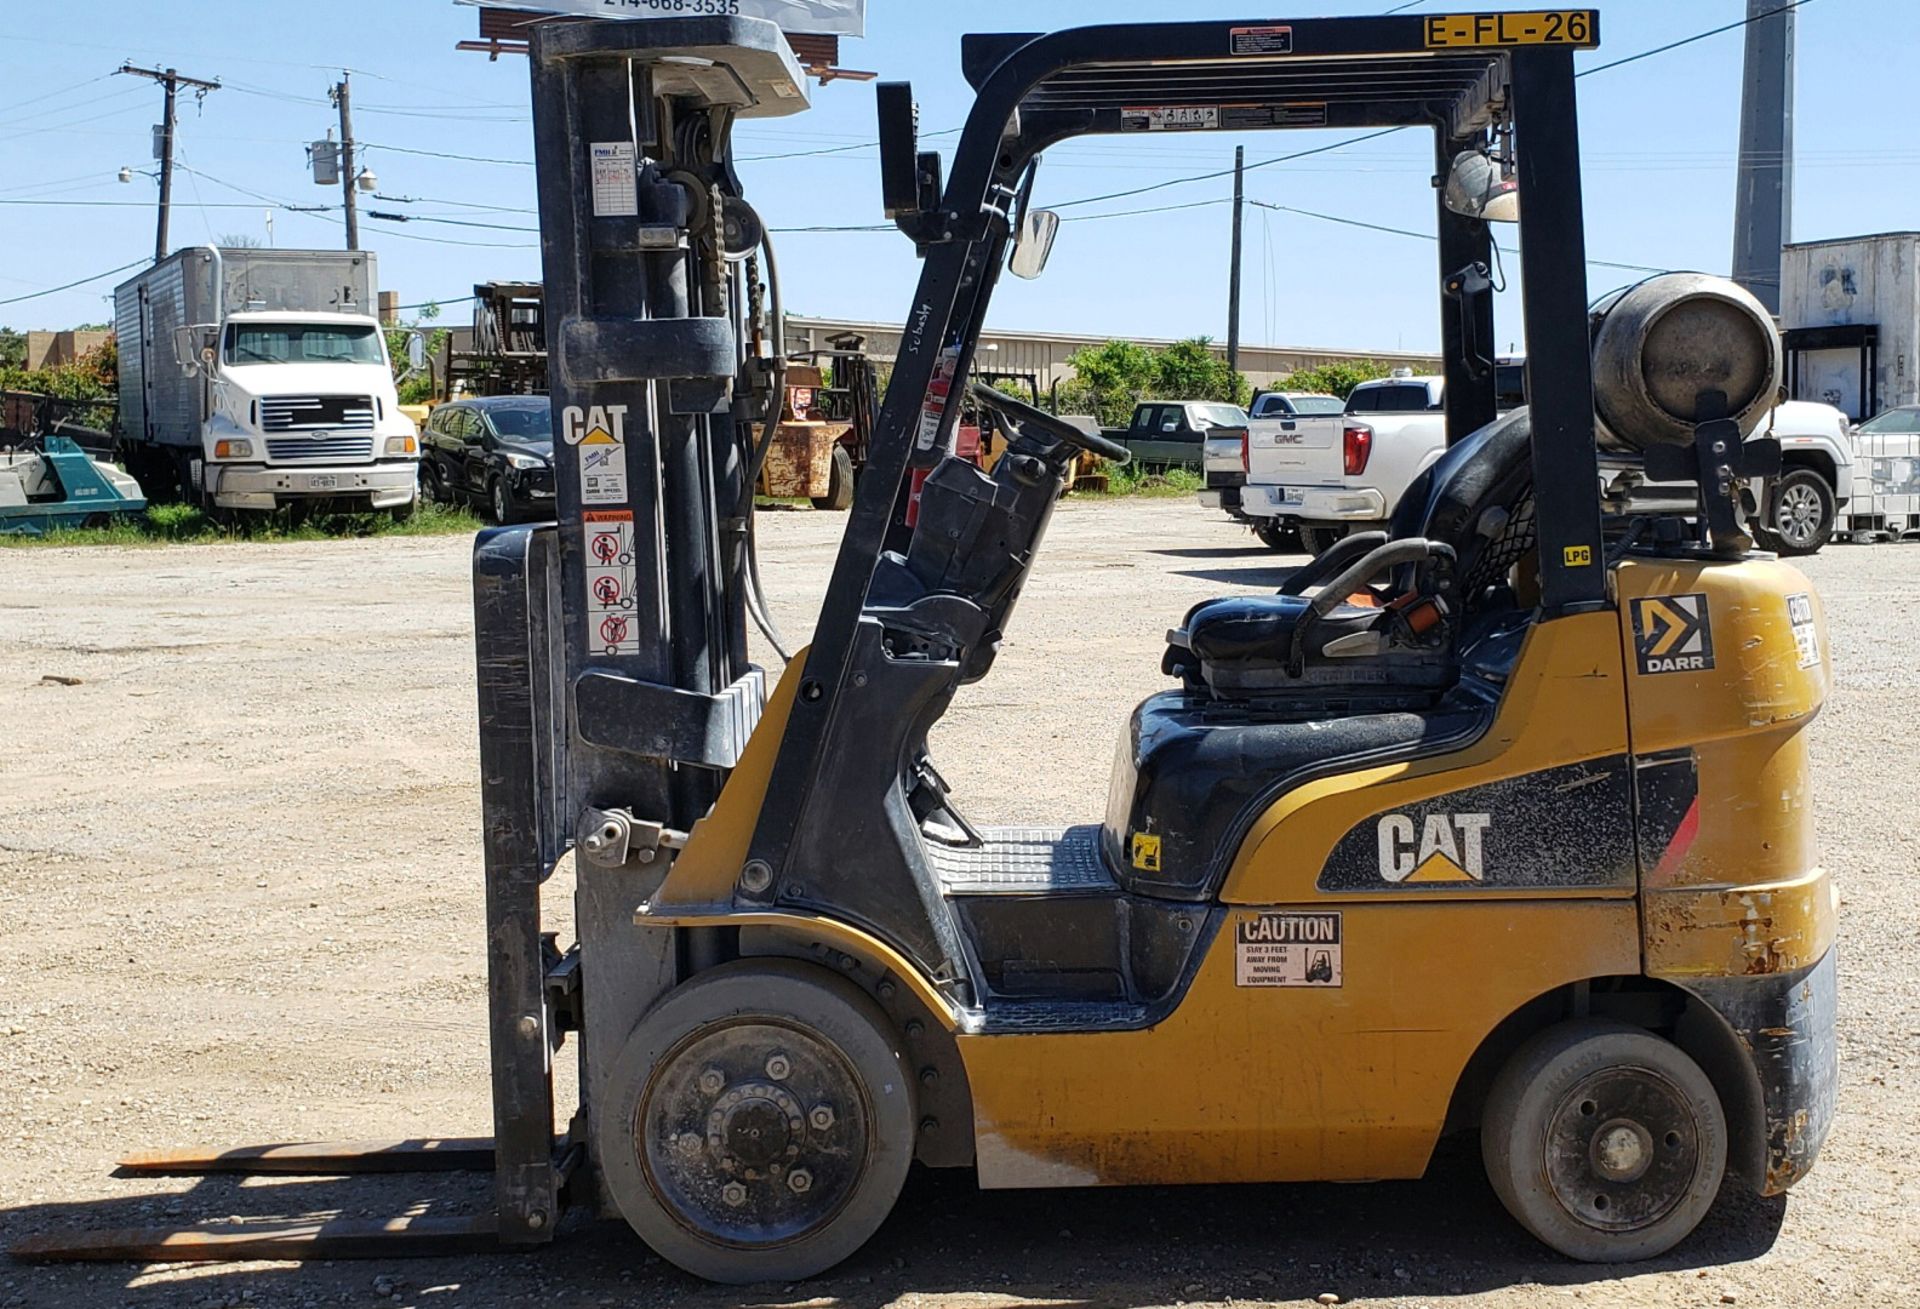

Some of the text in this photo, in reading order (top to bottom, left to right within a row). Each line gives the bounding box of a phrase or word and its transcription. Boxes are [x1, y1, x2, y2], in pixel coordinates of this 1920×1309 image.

[1428, 12, 1587, 45] E-FL-26
[562, 404, 628, 445] CAT
[1274, 434, 1304, 444] GMC
[1565, 549, 1589, 563] LPG
[1647, 656, 1704, 672] DARR
[1378, 813, 1490, 882] CAT
[1244, 917, 1334, 941] CAUTION
